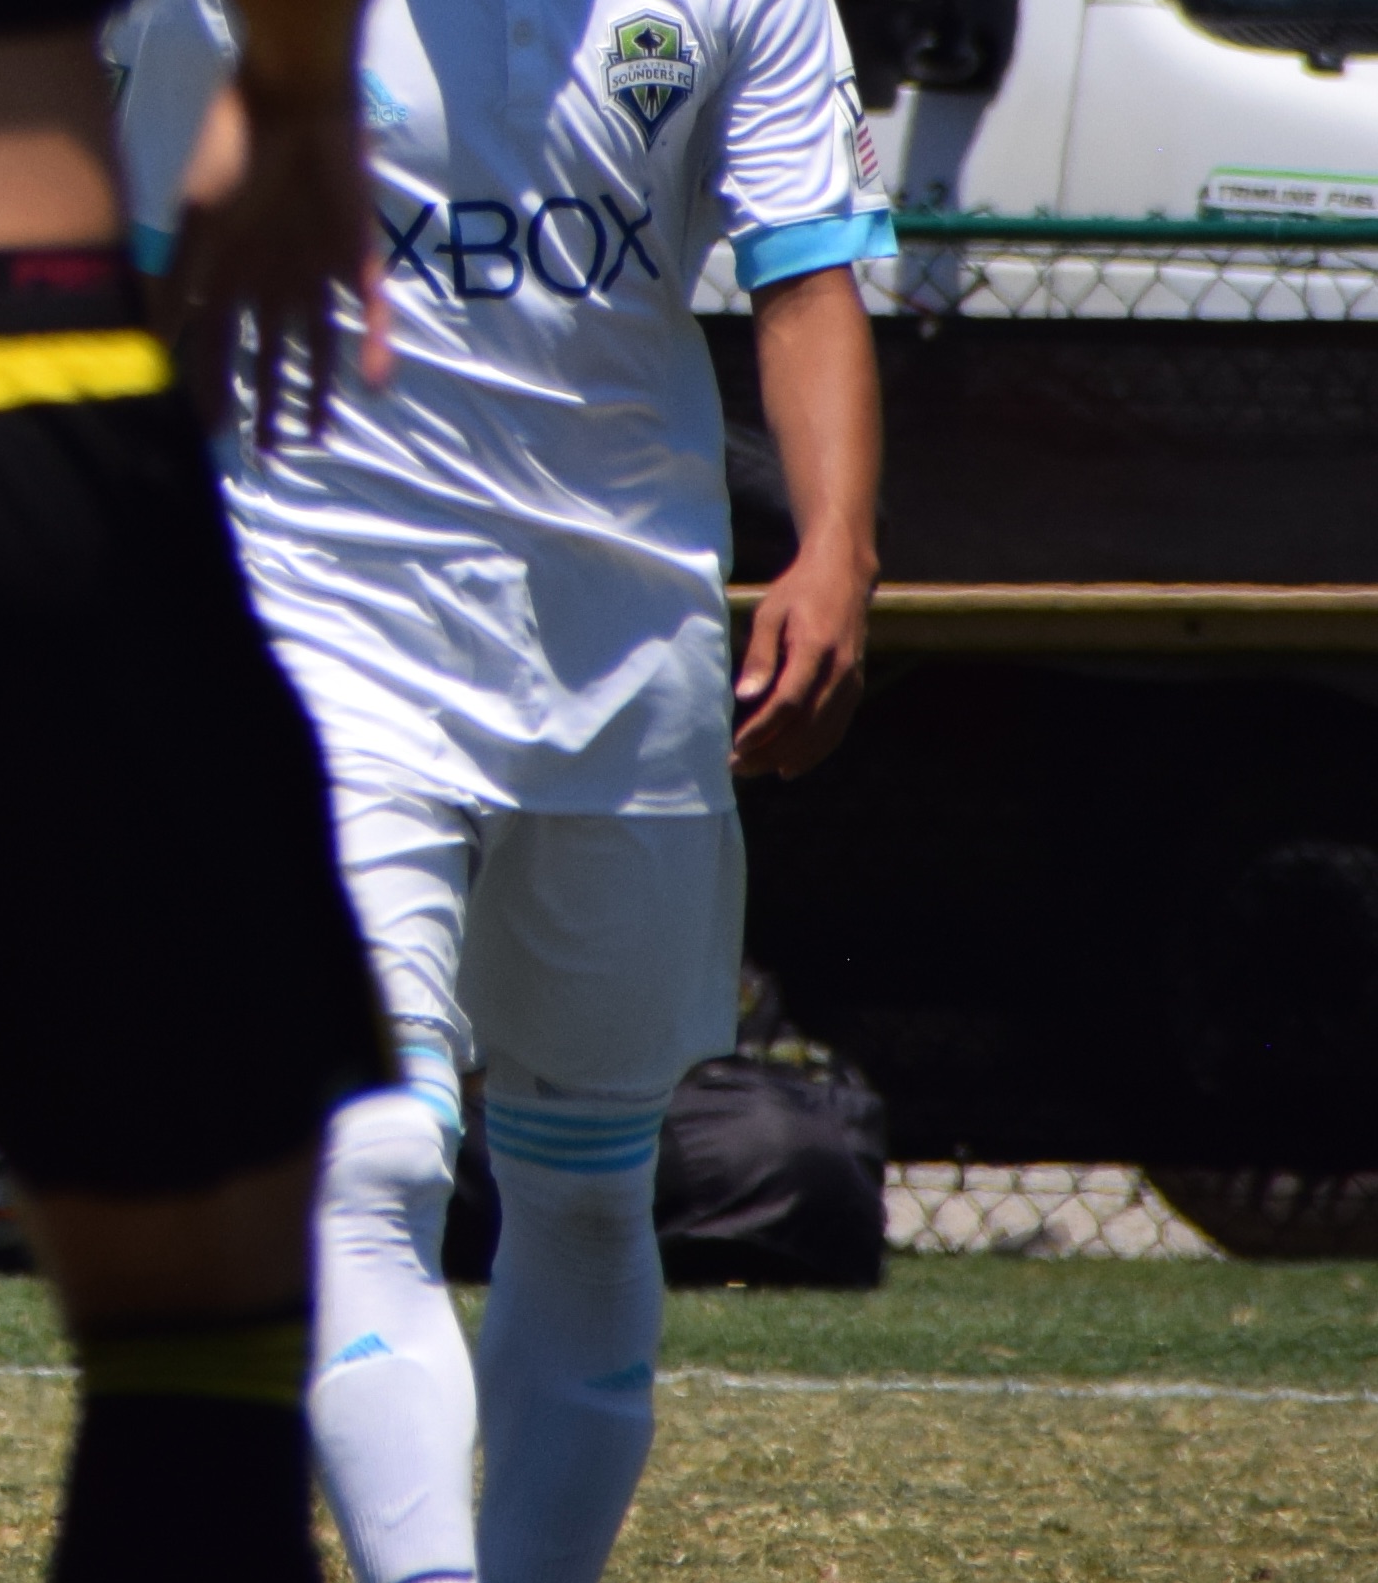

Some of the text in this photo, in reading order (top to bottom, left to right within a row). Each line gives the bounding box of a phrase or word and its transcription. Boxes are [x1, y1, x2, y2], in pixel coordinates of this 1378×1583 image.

[611, 69, 692, 89] SOUNDERS FC
[379, 192, 661, 301] XBOX
